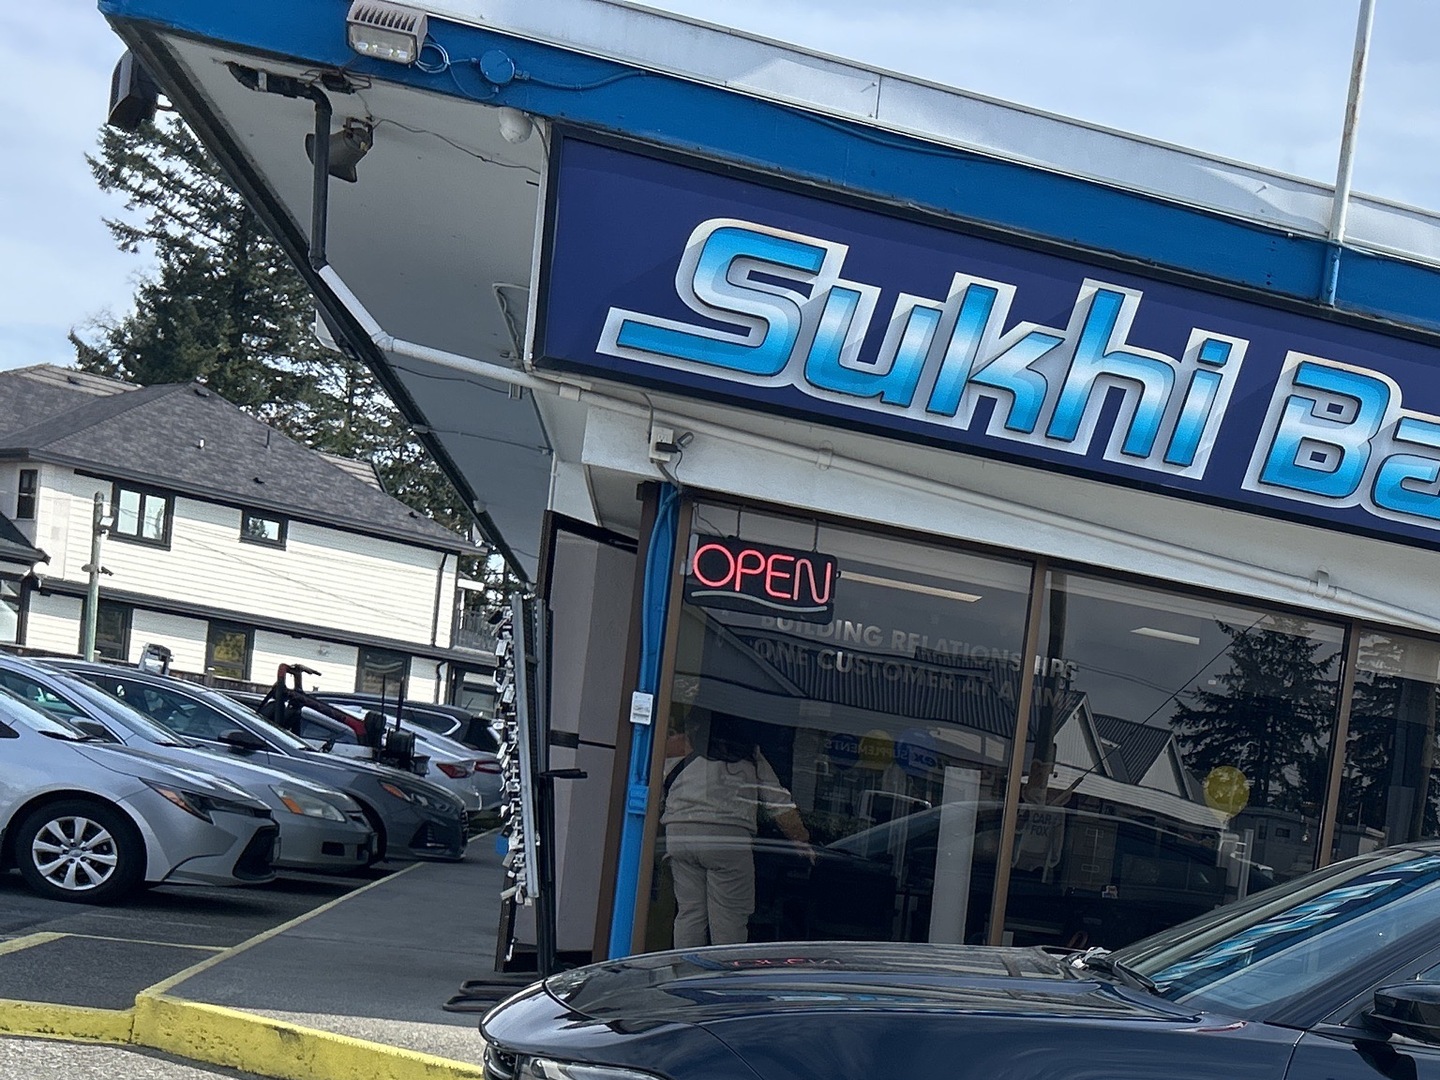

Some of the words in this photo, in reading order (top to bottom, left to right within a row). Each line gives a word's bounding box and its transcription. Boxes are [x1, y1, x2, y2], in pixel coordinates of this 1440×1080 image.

[596, 218, 1249, 480] Sukhi
[693, 543, 832, 604] OPEN
[817, 649, 953, 690] CUSTOMER
